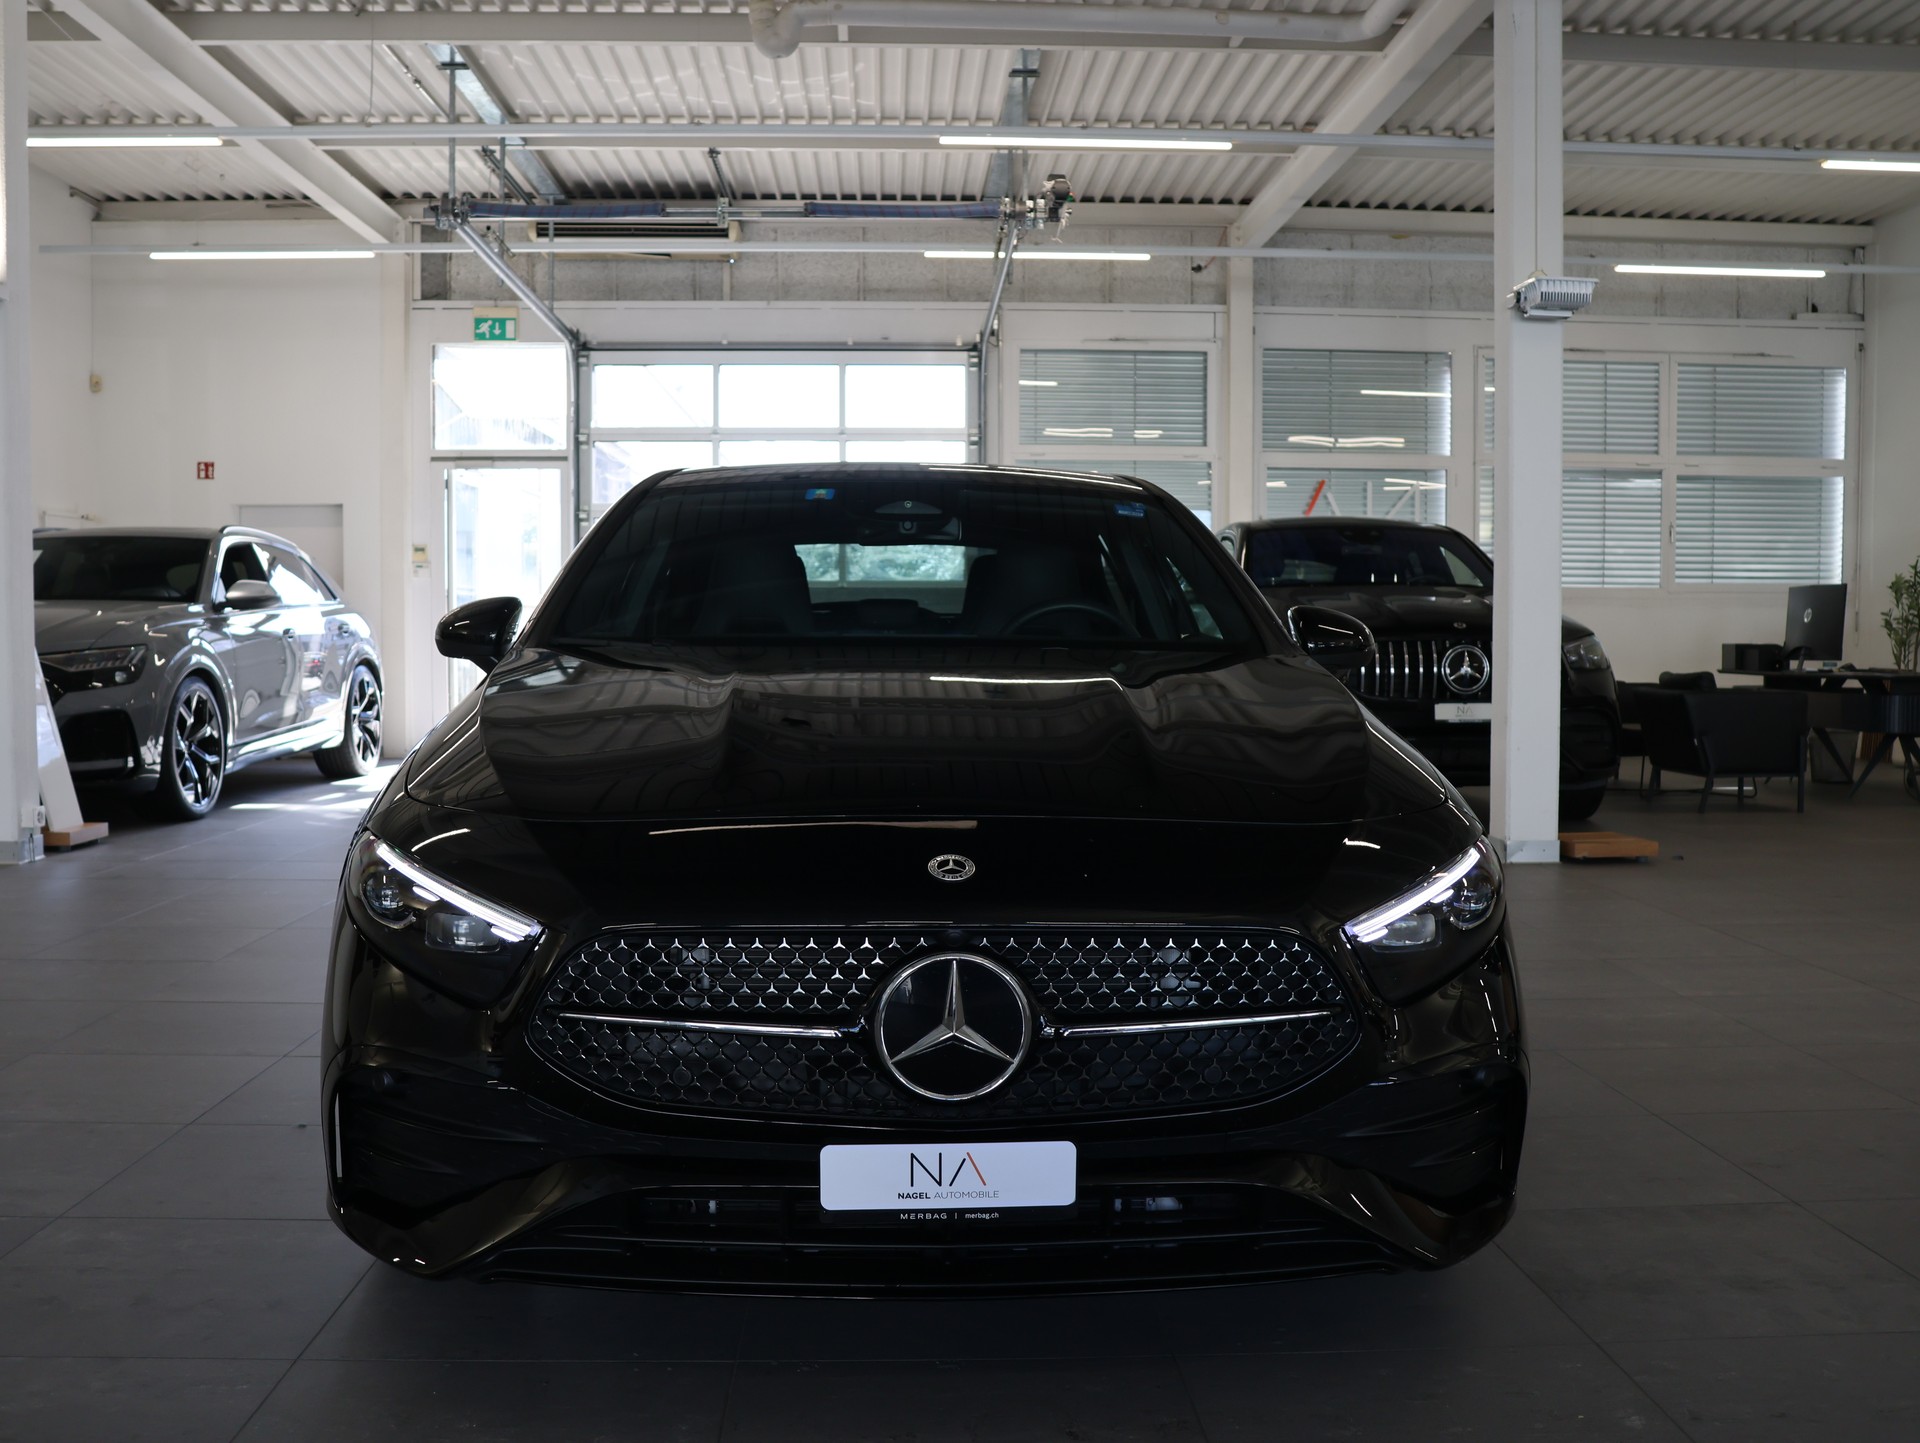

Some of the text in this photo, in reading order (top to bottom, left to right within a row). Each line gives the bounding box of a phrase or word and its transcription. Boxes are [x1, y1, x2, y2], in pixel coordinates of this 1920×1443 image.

[910, 1152, 986, 1187] NA
[897, 1190, 1000, 1200] NAGEL AUTOMOBILE
[900, 1212, 1000, 1220] MERBAG merbag.ch
